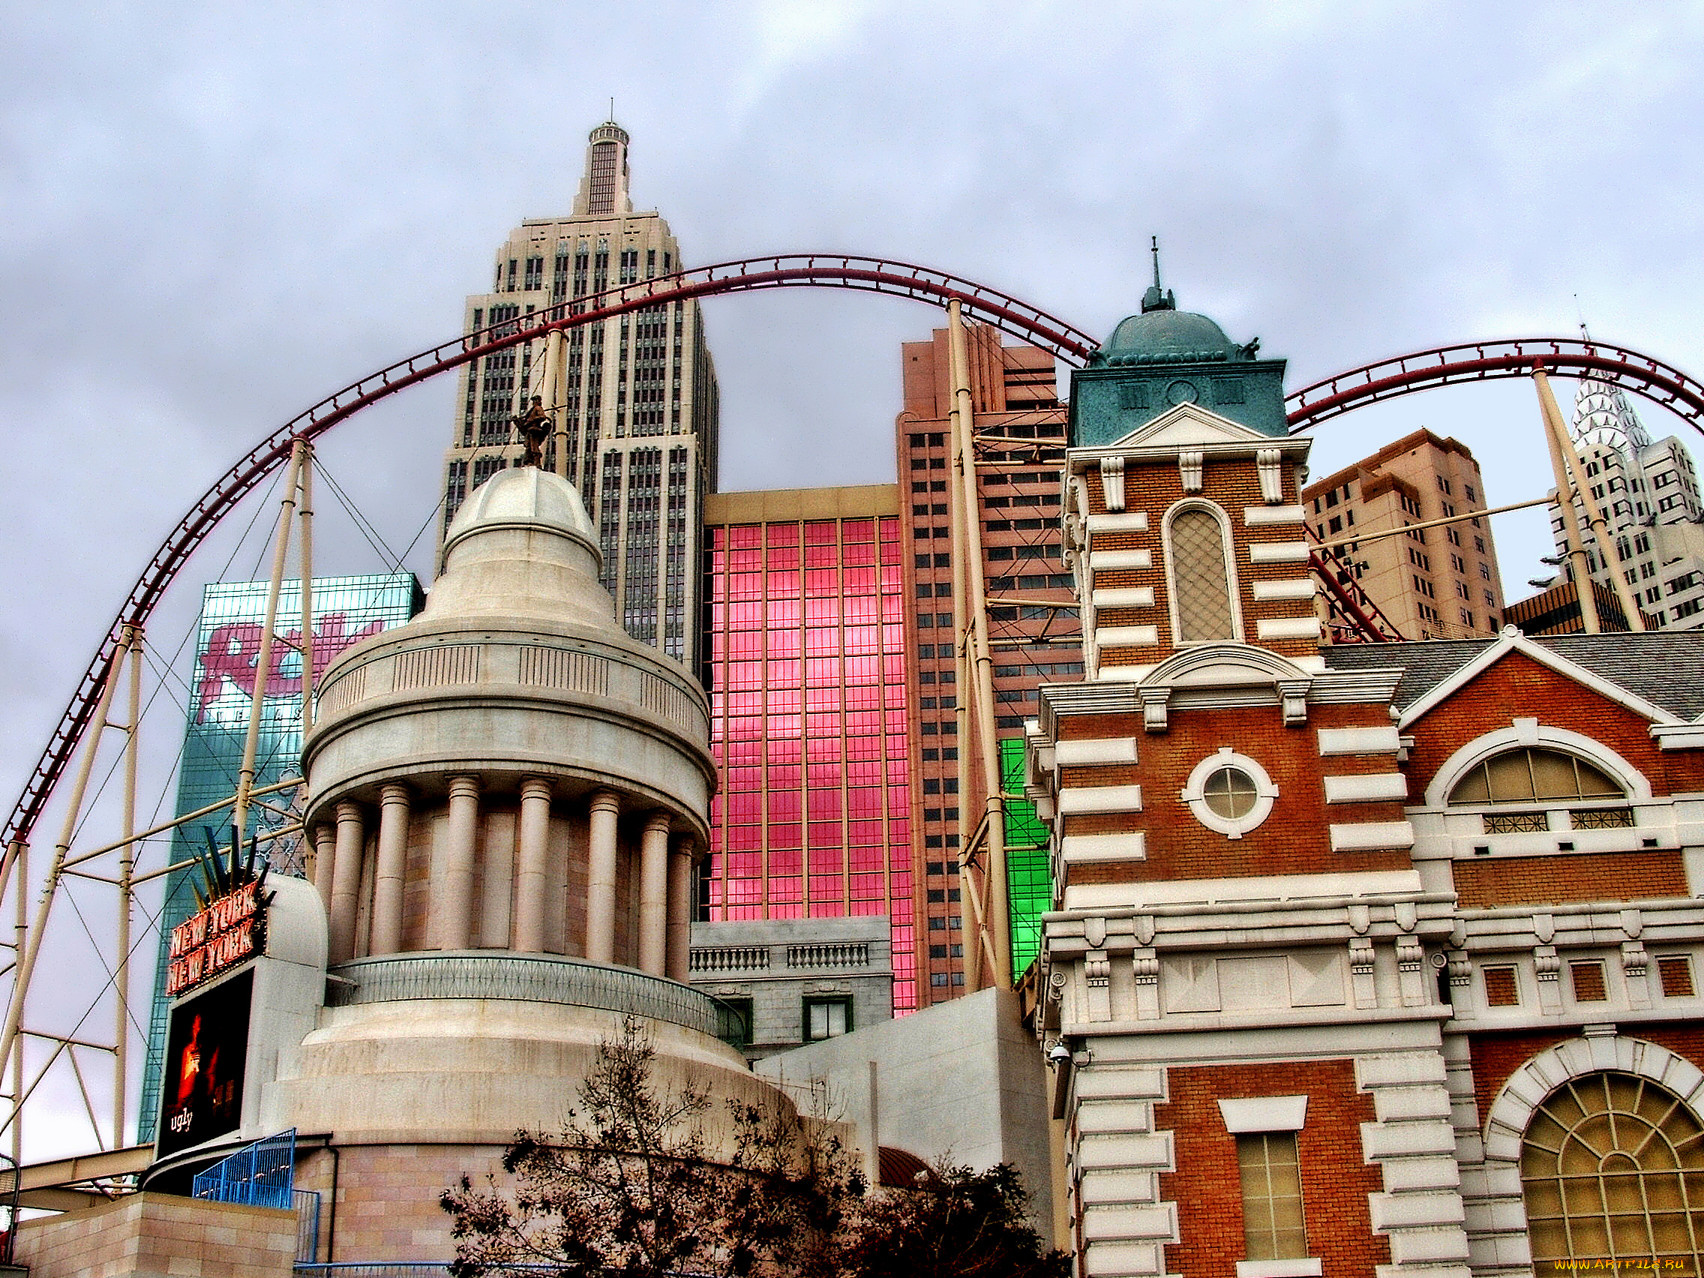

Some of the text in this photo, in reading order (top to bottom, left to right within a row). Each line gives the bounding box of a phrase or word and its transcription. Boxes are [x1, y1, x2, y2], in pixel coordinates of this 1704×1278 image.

[166, 918, 254, 996] NEW YORK
[170, 881, 257, 960] NEW YORK
[171, 1107, 193, 1132] ugly
